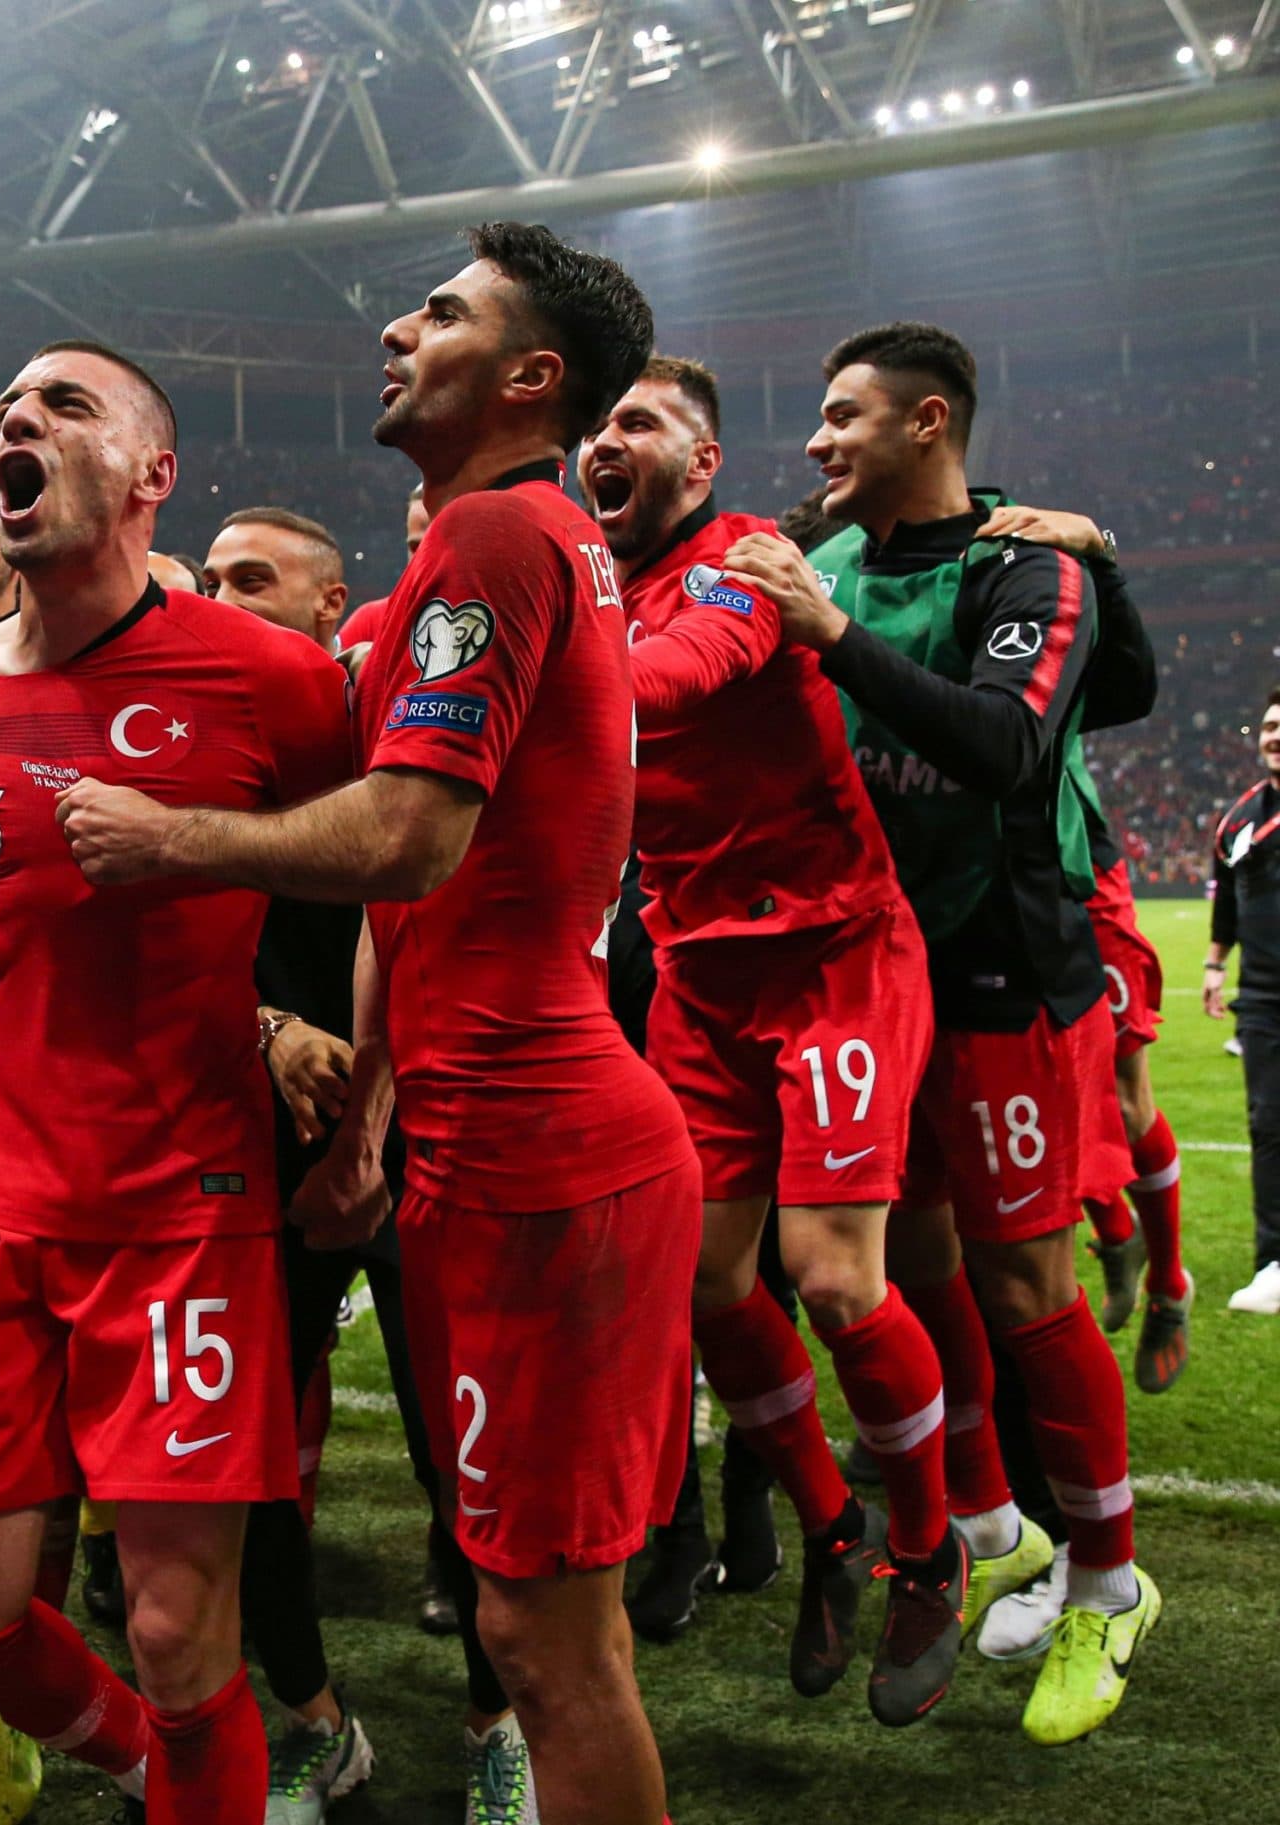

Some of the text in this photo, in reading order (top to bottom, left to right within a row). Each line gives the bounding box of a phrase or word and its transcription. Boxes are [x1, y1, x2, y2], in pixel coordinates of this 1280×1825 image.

[708, 591, 752, 609] SPECT
[407, 702, 485, 724] RESPECT
[800, 1038, 877, 1129] 19
[971, 1095, 1046, 1175] 18
[148, 1298, 234, 1403] 15
[455, 1375, 488, 1483] 2
